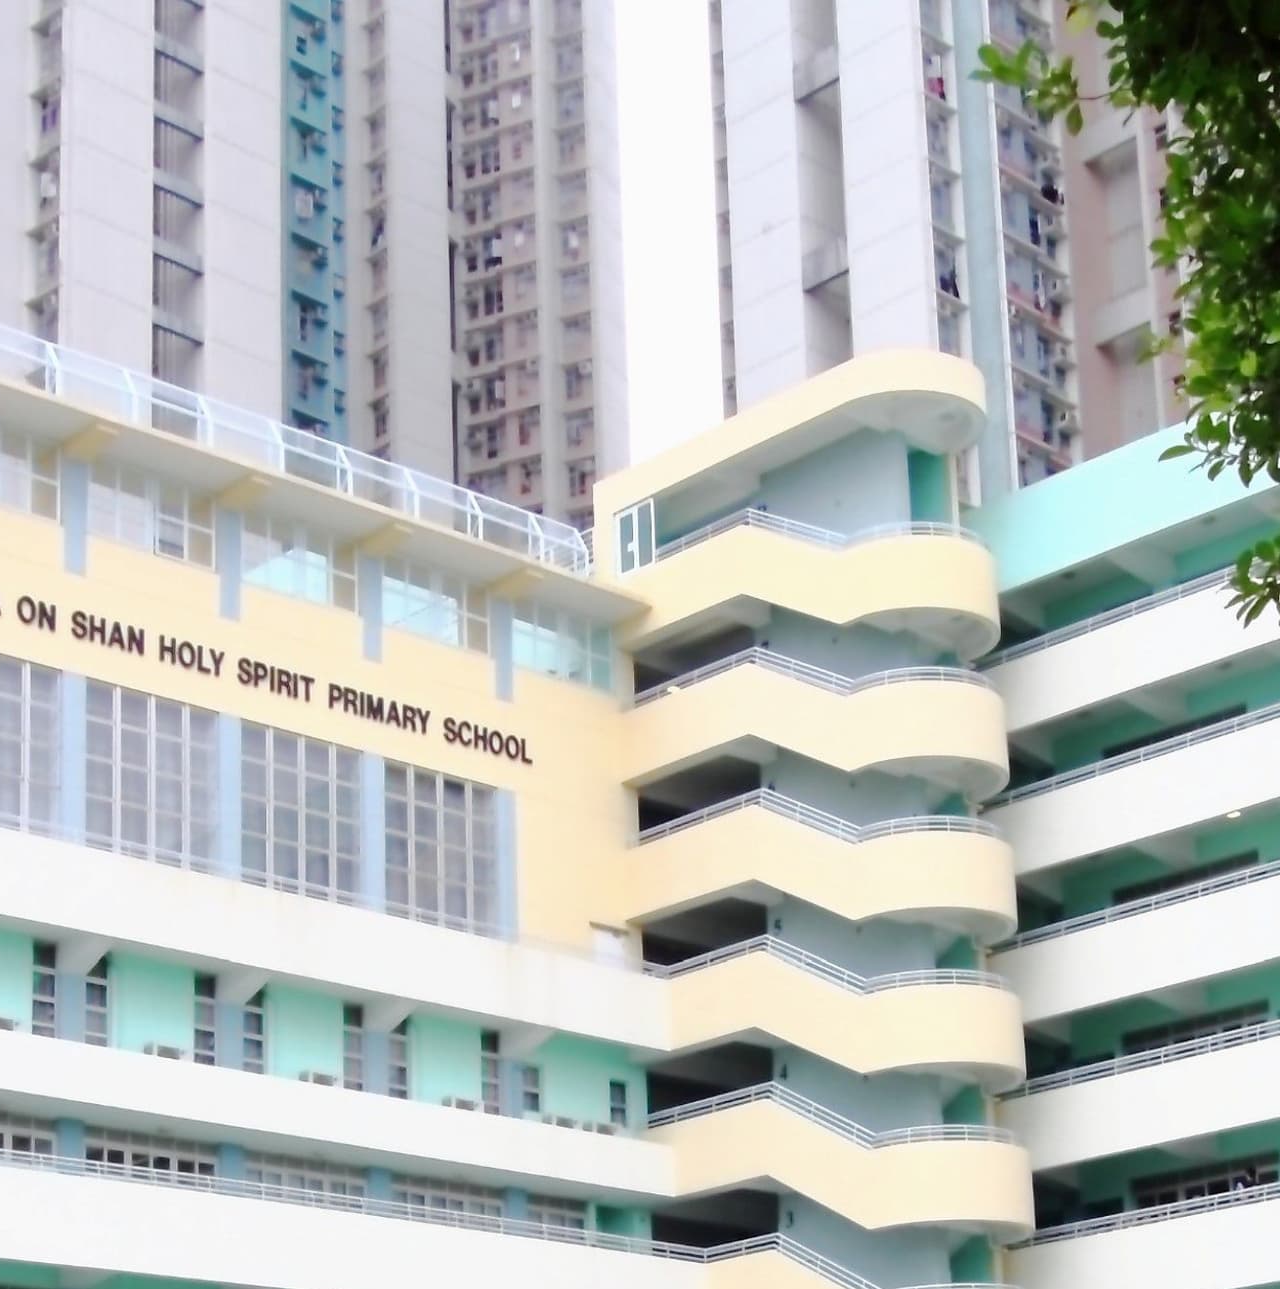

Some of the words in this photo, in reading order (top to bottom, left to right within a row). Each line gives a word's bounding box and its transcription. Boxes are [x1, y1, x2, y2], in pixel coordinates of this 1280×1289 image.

[17, 596, 56, 631] ON
[71, 610, 145, 656] SHAN
[159, 634, 225, 677] HOLY
[237, 658, 315, 702] SPIRIT
[328, 683, 431, 735] PRIMARY
[443, 717, 533, 765] SCHOOL
